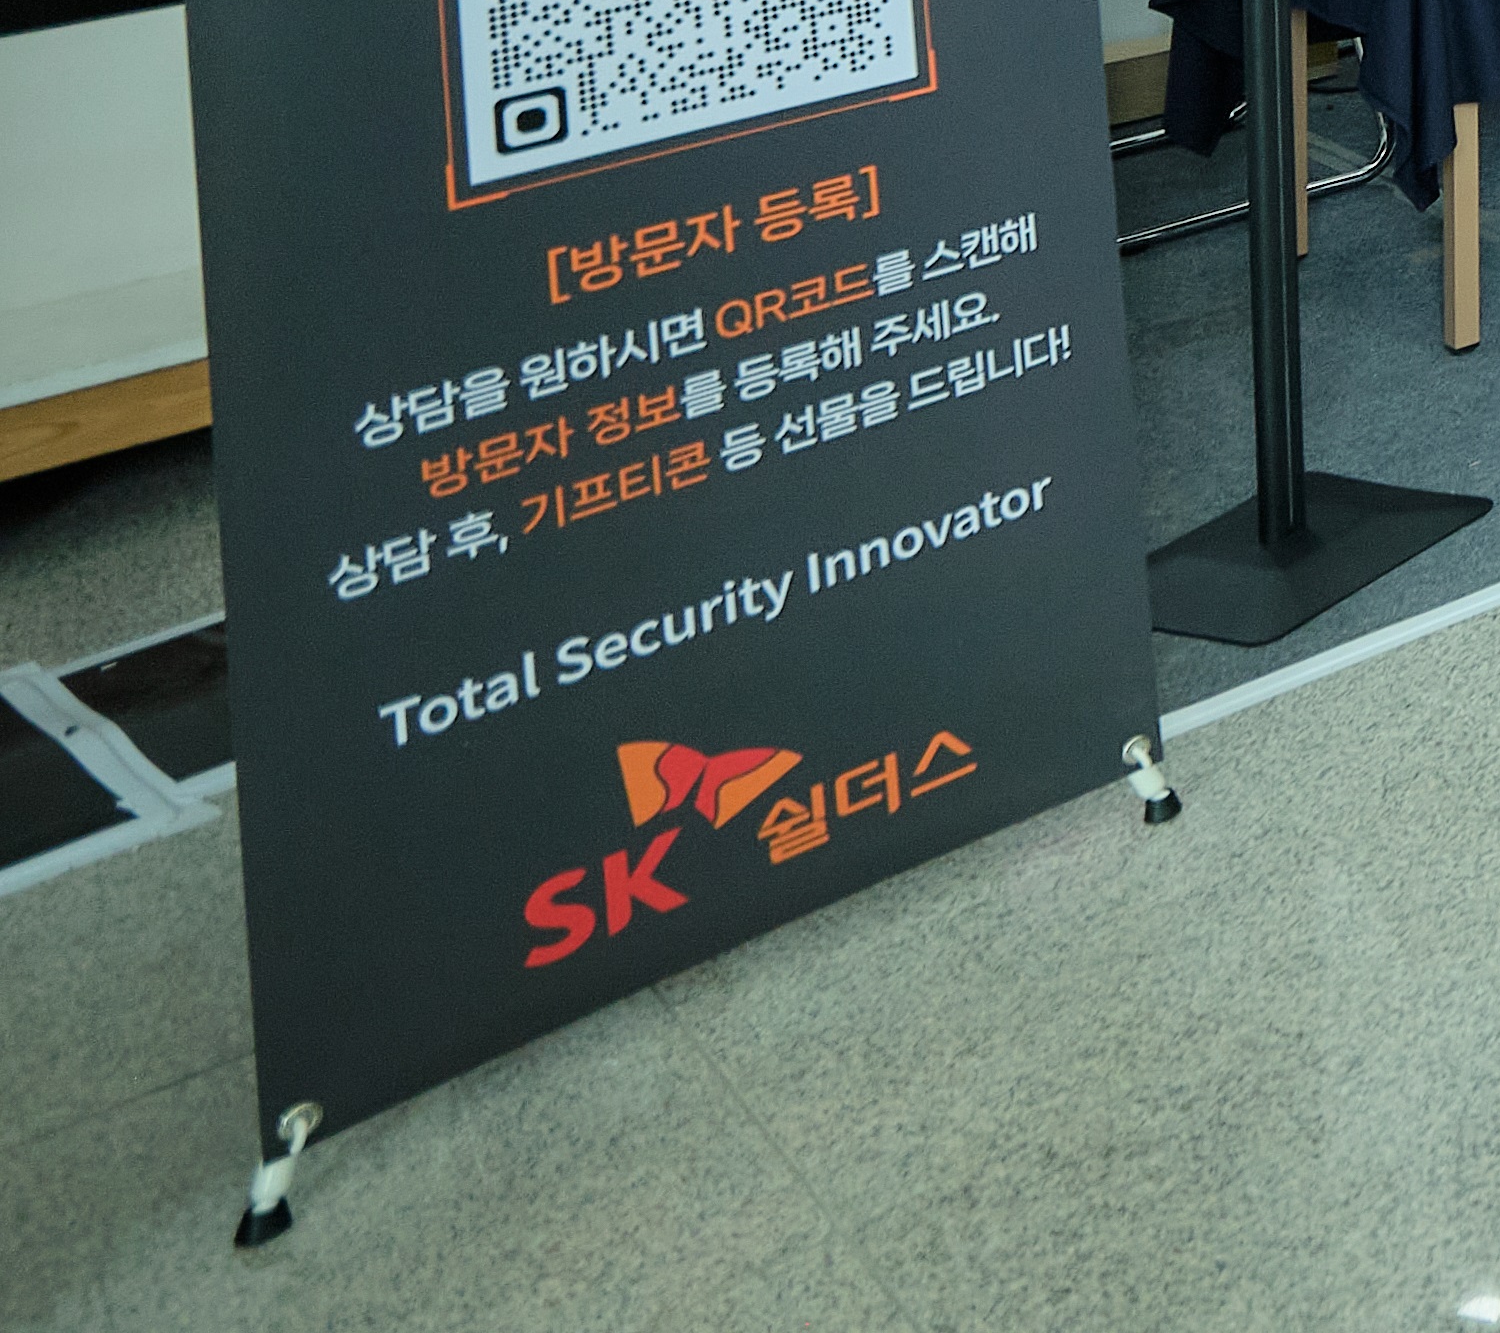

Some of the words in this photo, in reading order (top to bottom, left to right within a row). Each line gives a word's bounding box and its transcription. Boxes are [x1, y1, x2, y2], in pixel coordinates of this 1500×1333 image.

[353, 365, 511, 450] 상담을
[519, 309, 705, 397] 원하시면
[714, 250, 917, 342] QR코드를
[922, 212, 1039, 285] 스캔해
[546, 204, 741, 305] [방문자
[752, 164, 881, 245] 등록]
[326, 530, 437, 601] 상담
[446, 507, 510, 564] 후,
[521, 440, 713, 538] 기프티콘
[719, 424, 766, 472] 등
[773, 384, 900, 455] 선물을
[906, 324, 1073, 411] 드립니다!
[420, 424, 575, 500] 방문자
[584, 365, 726, 442] 정보를
[733, 326, 863, 402] 등록해
[870, 290, 1001, 363] 주세요.
[379, 650, 538, 747] Total
[555, 566, 795, 685] Security
[806, 473, 1053, 592] Innovator
[522, 827, 689, 968] SK
[757, 730, 978, 865] 쉴더스
